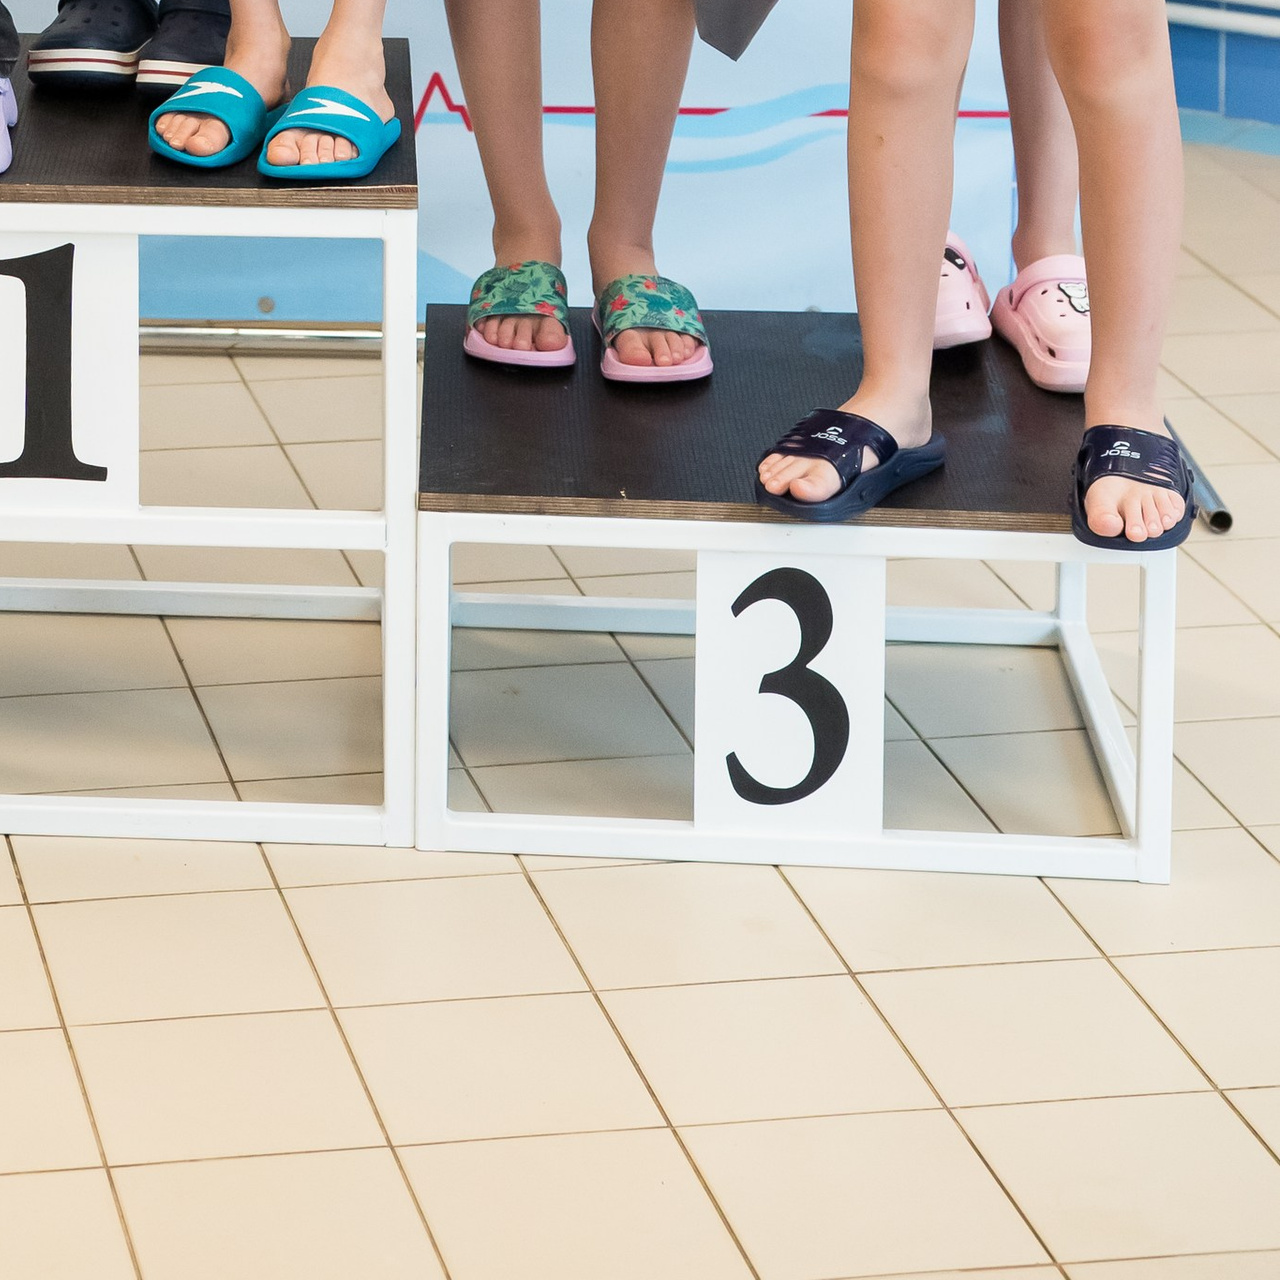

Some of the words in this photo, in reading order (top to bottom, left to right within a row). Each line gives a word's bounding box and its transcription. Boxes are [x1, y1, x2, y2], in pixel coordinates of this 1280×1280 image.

[810, 431, 848, 446] JOSS
[1100, 448, 1142, 460] JOSS
[726, 566, 853, 807] 3
